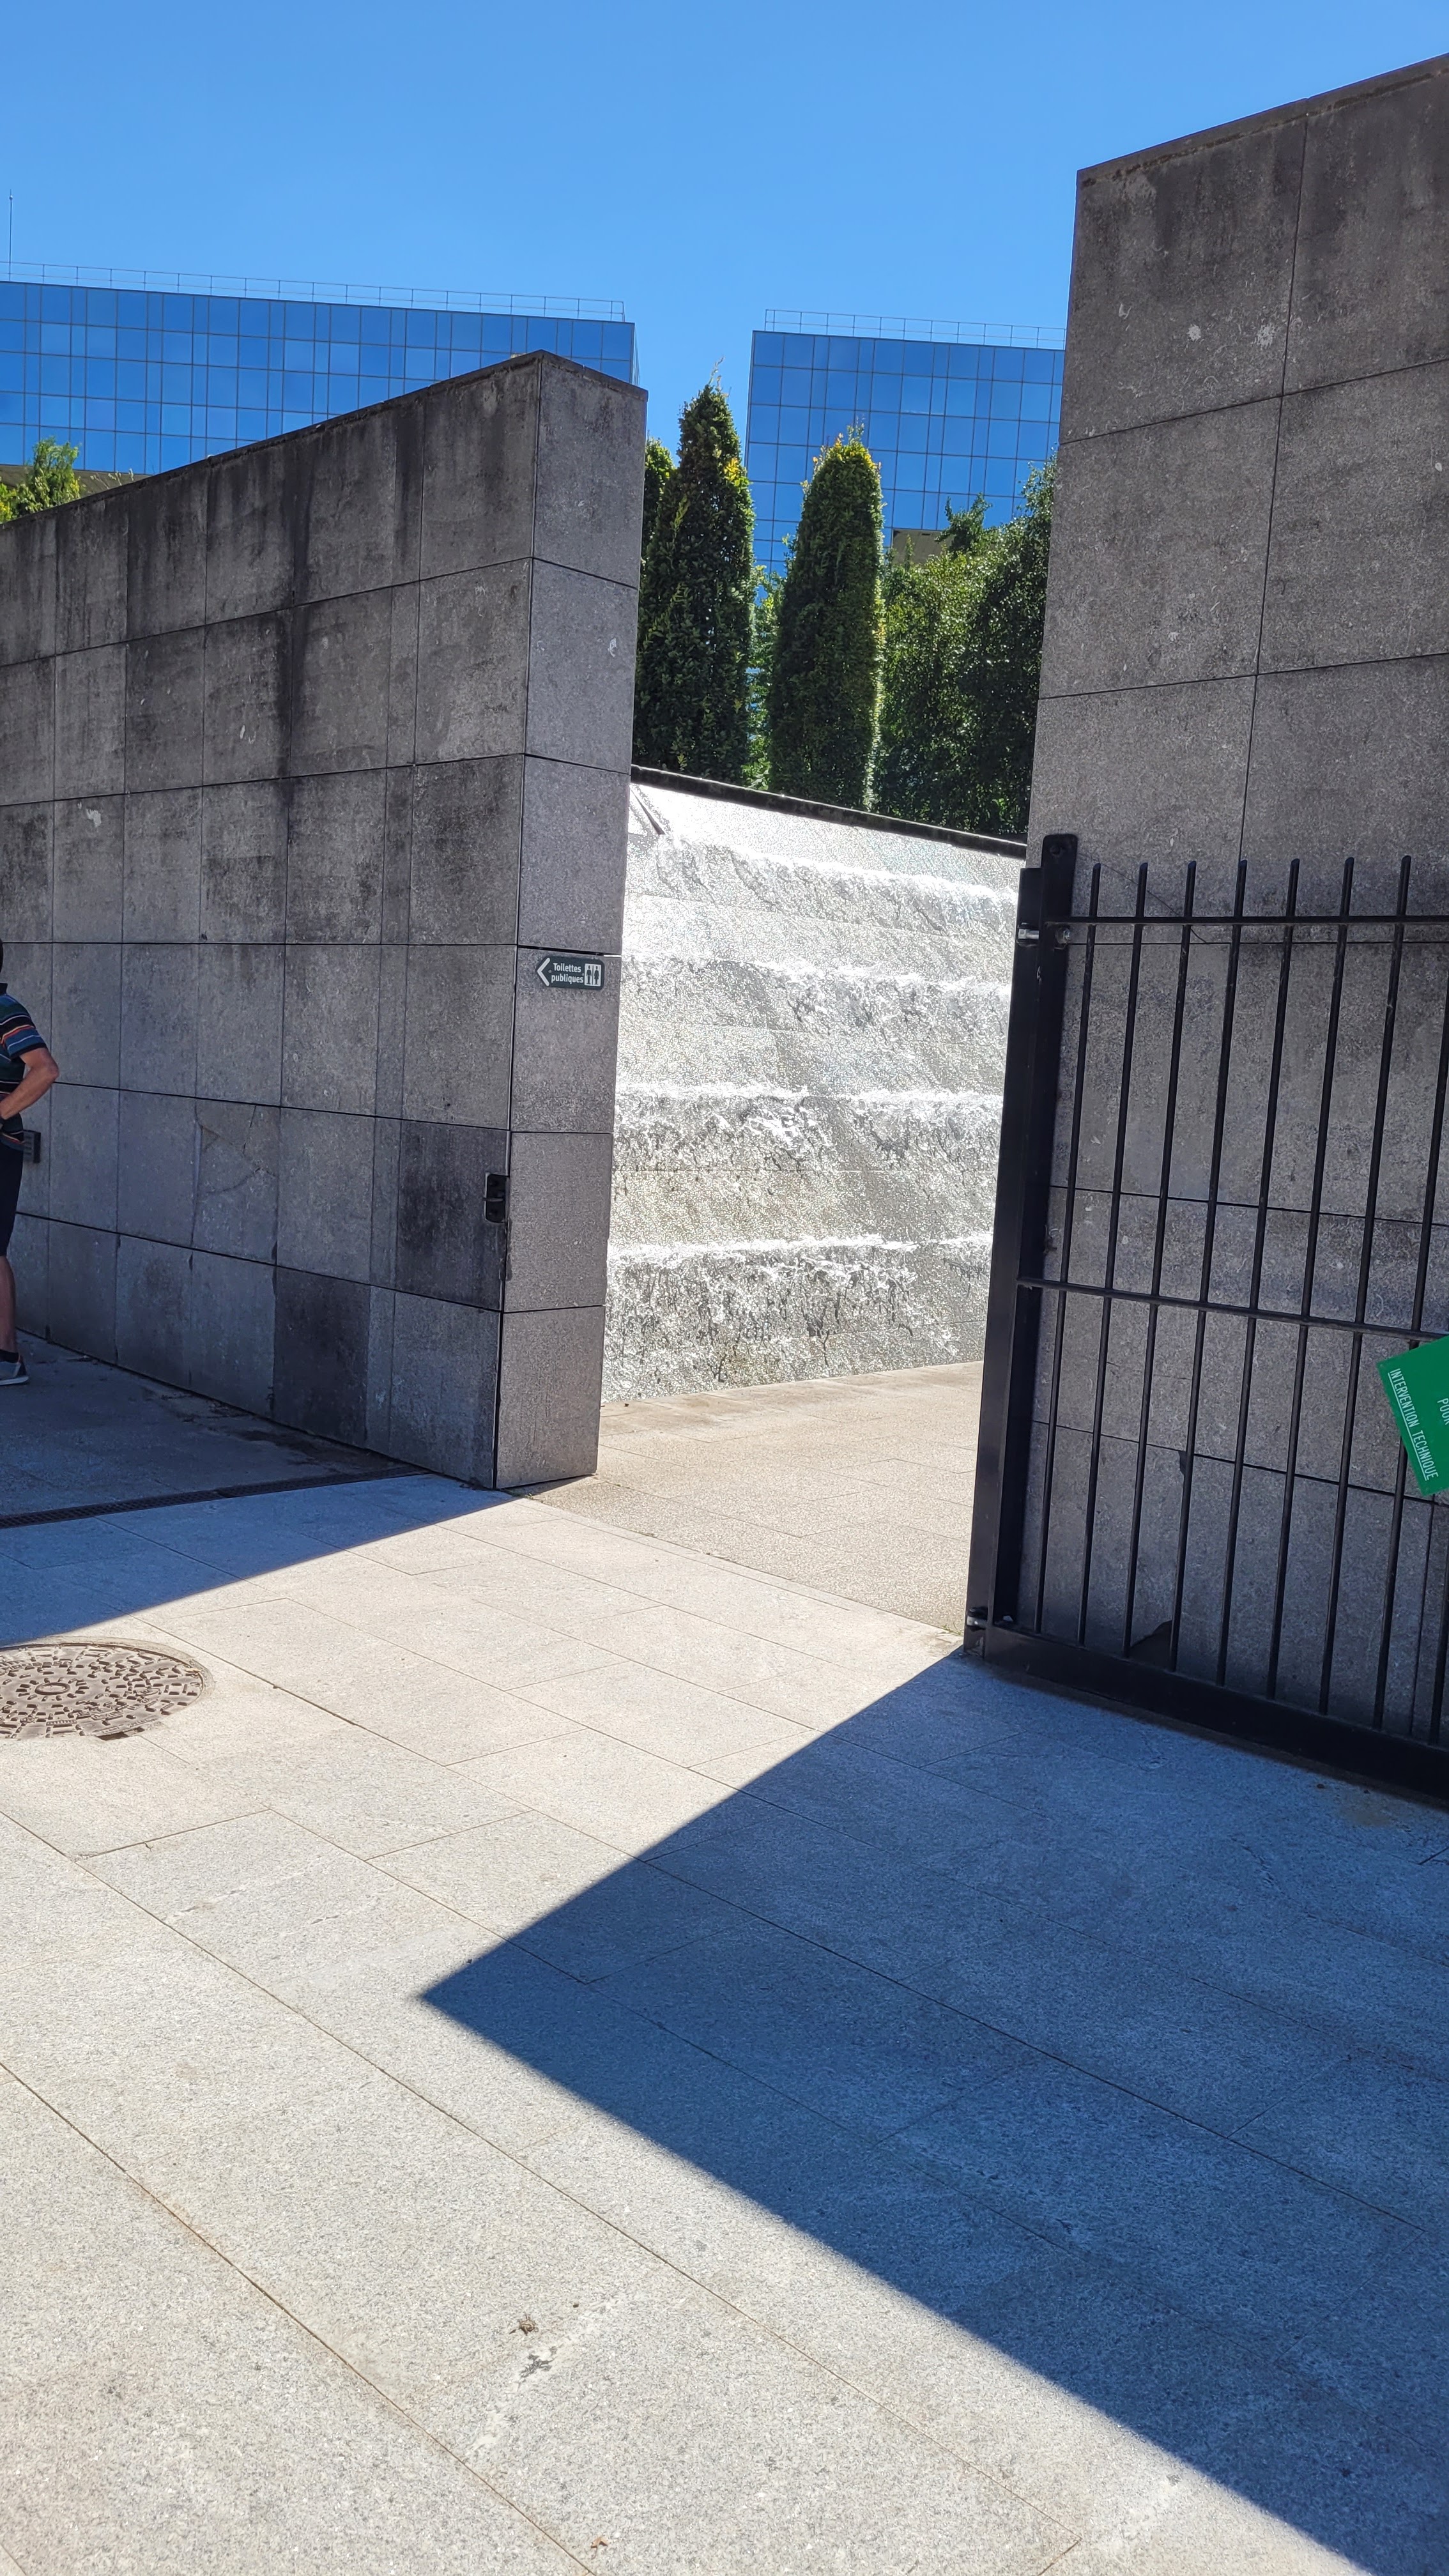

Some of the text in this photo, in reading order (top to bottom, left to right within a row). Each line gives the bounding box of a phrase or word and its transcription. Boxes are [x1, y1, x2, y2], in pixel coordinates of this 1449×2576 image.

[553, 962, 581, 973] Toilettes
[551, 974, 584, 985] publiques
[1390, 1368, 1439, 1481] INTERVENTION TECHNIQUE
